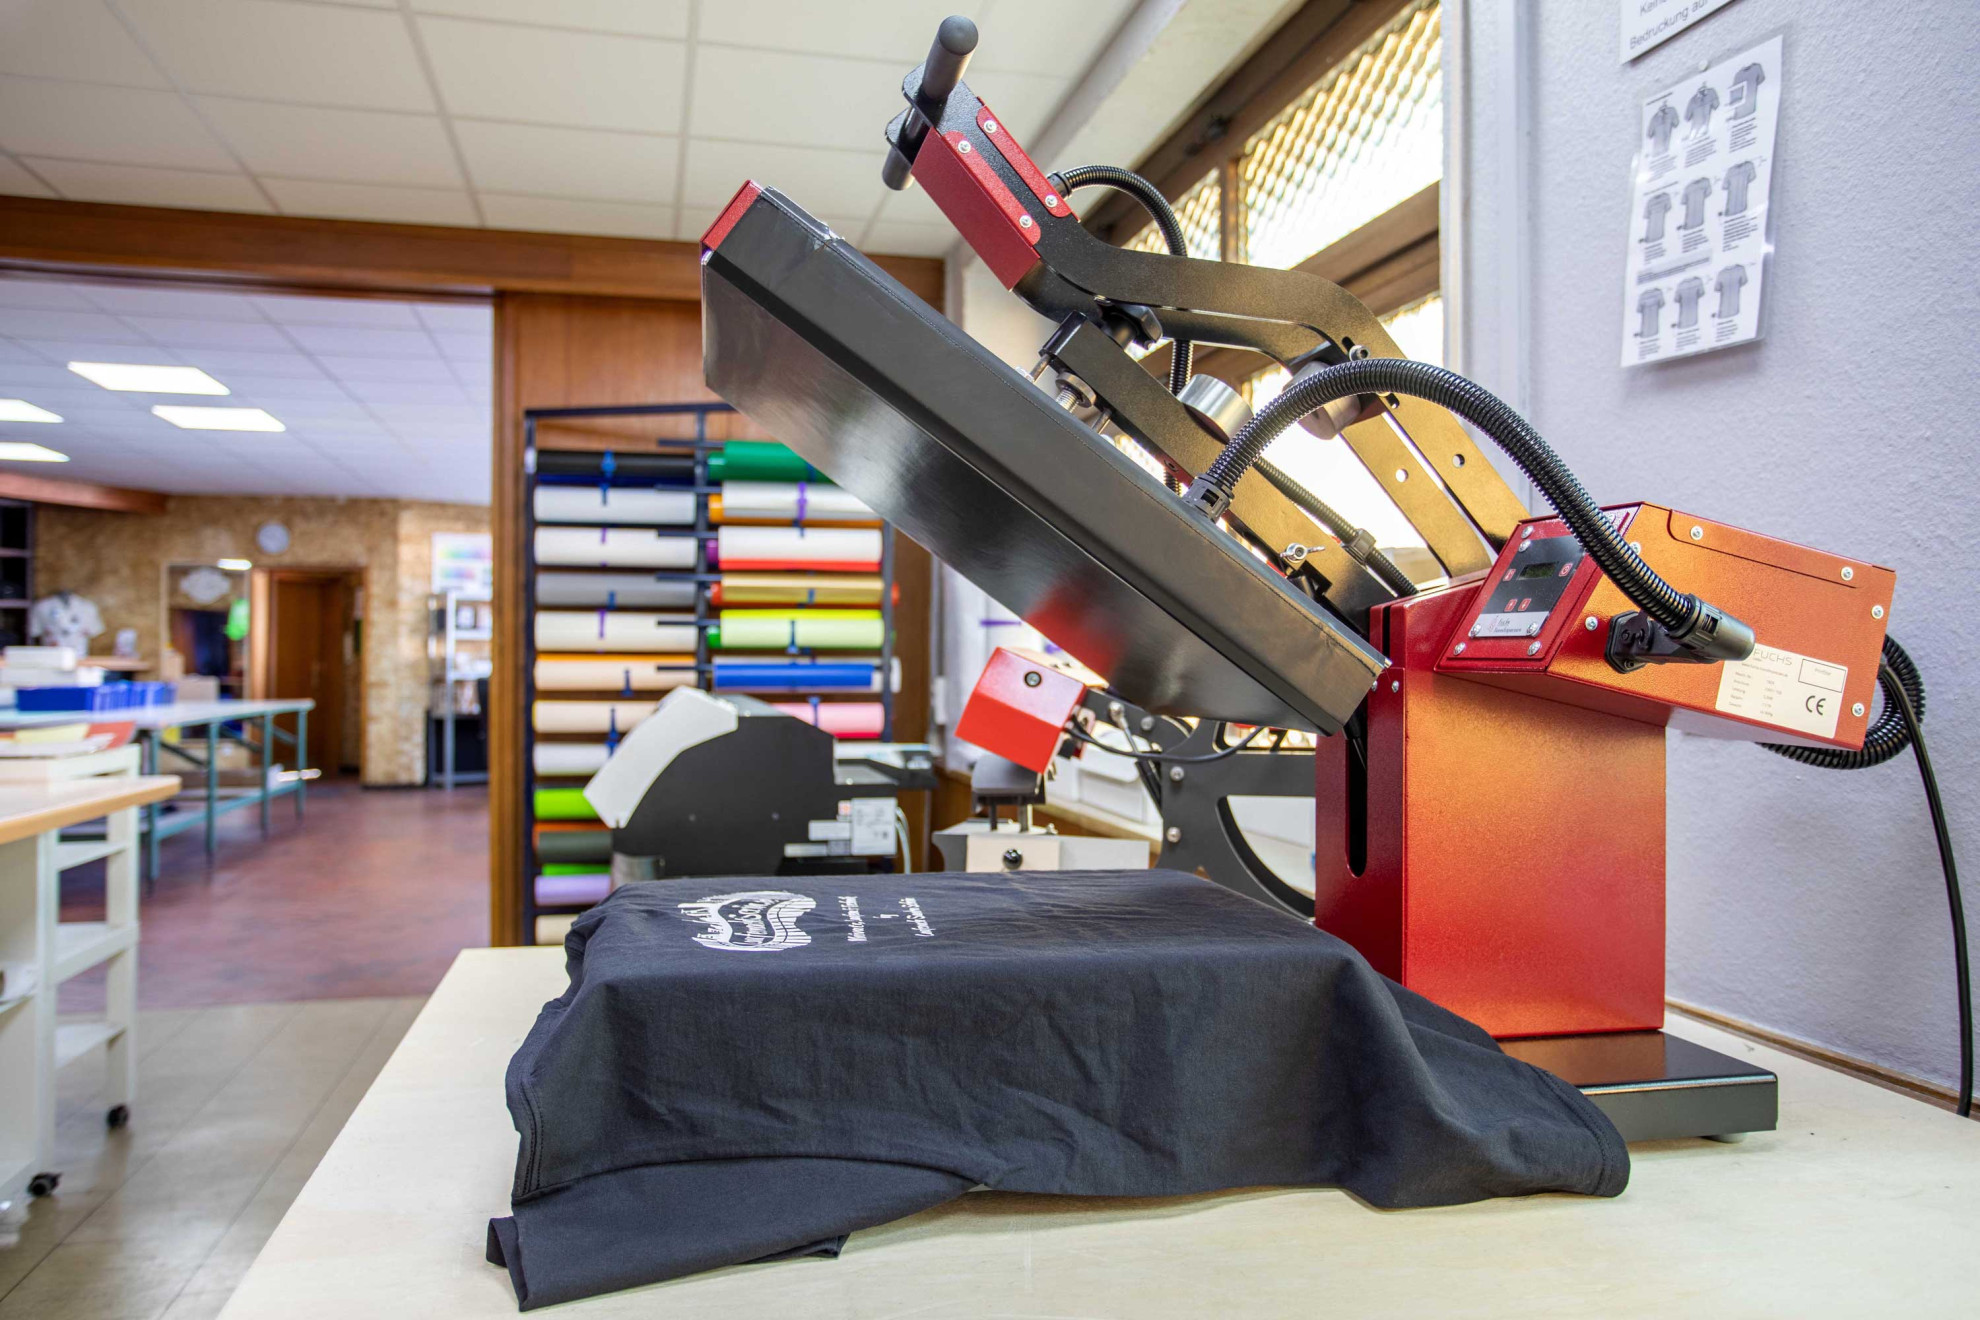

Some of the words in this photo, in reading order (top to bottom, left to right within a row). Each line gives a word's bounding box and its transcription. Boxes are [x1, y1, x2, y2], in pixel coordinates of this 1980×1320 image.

[1630, 7, 1689, 50] Bedruckung
[1752, 648, 1793, 666] FUCHS
[1805, 694, 1827, 716] CE
